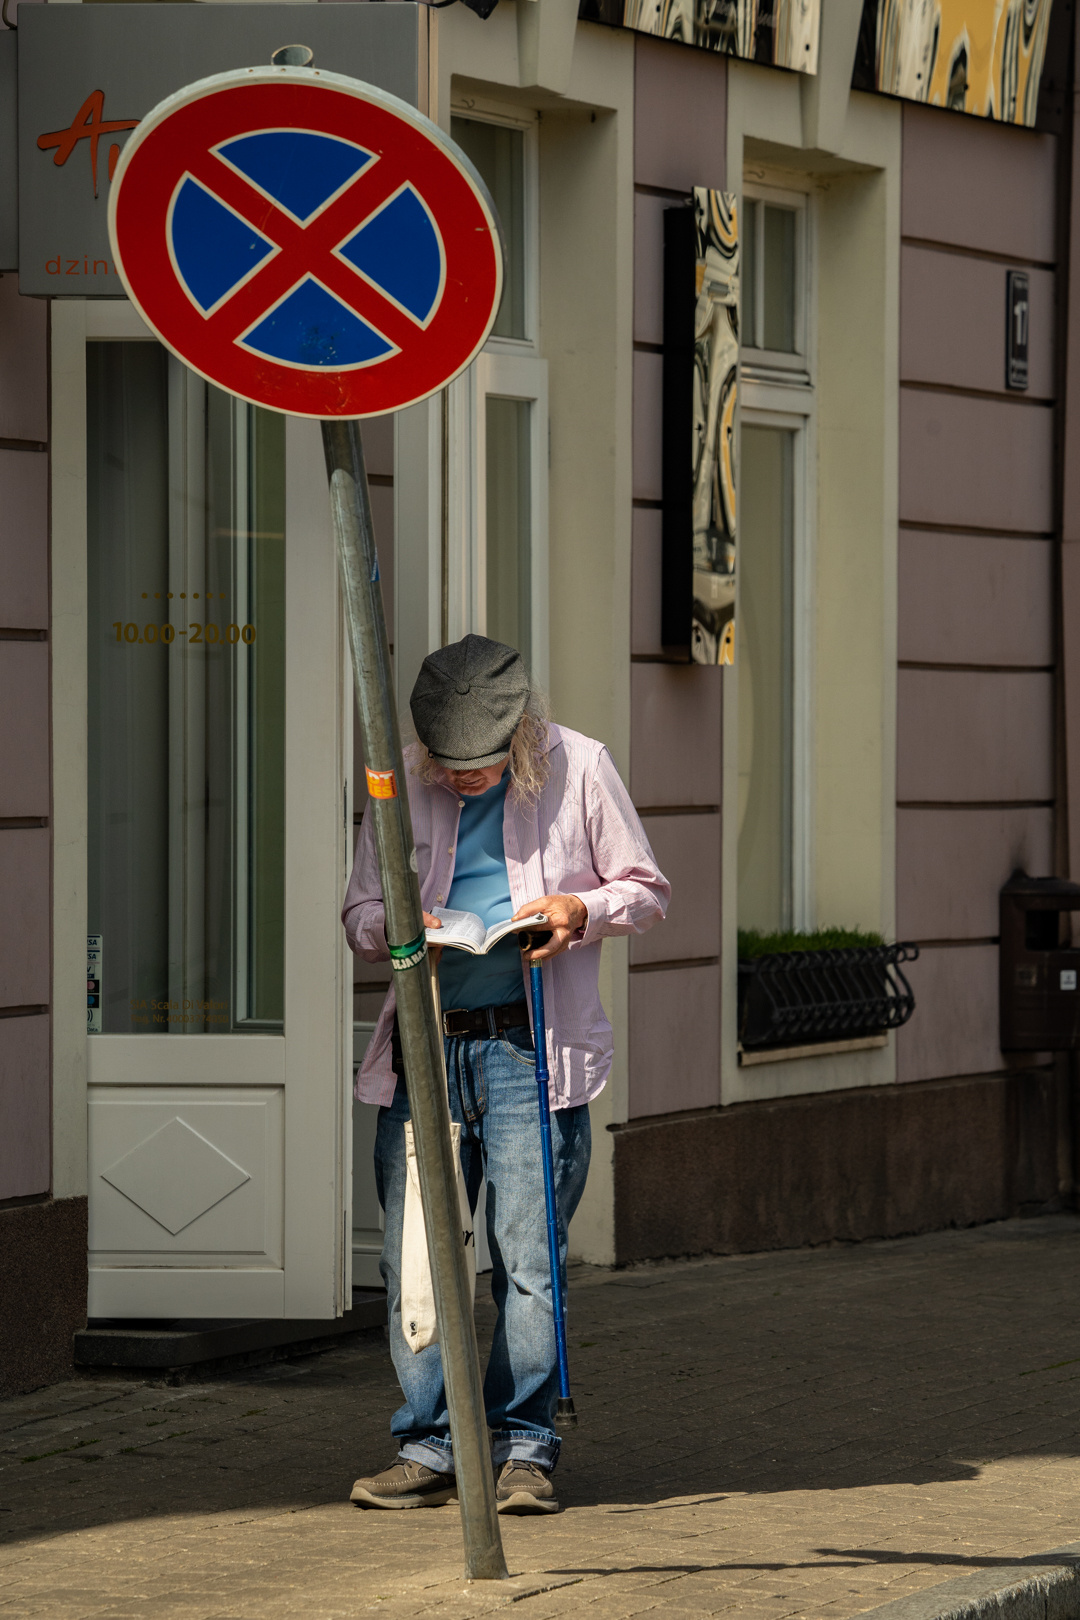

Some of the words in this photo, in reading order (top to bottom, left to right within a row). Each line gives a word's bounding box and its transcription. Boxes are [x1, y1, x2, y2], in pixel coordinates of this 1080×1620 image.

[129, 999, 148, 1010] SIA
[150, 999, 179, 1010] Scala
[182, 999, 194, 1010] Di
